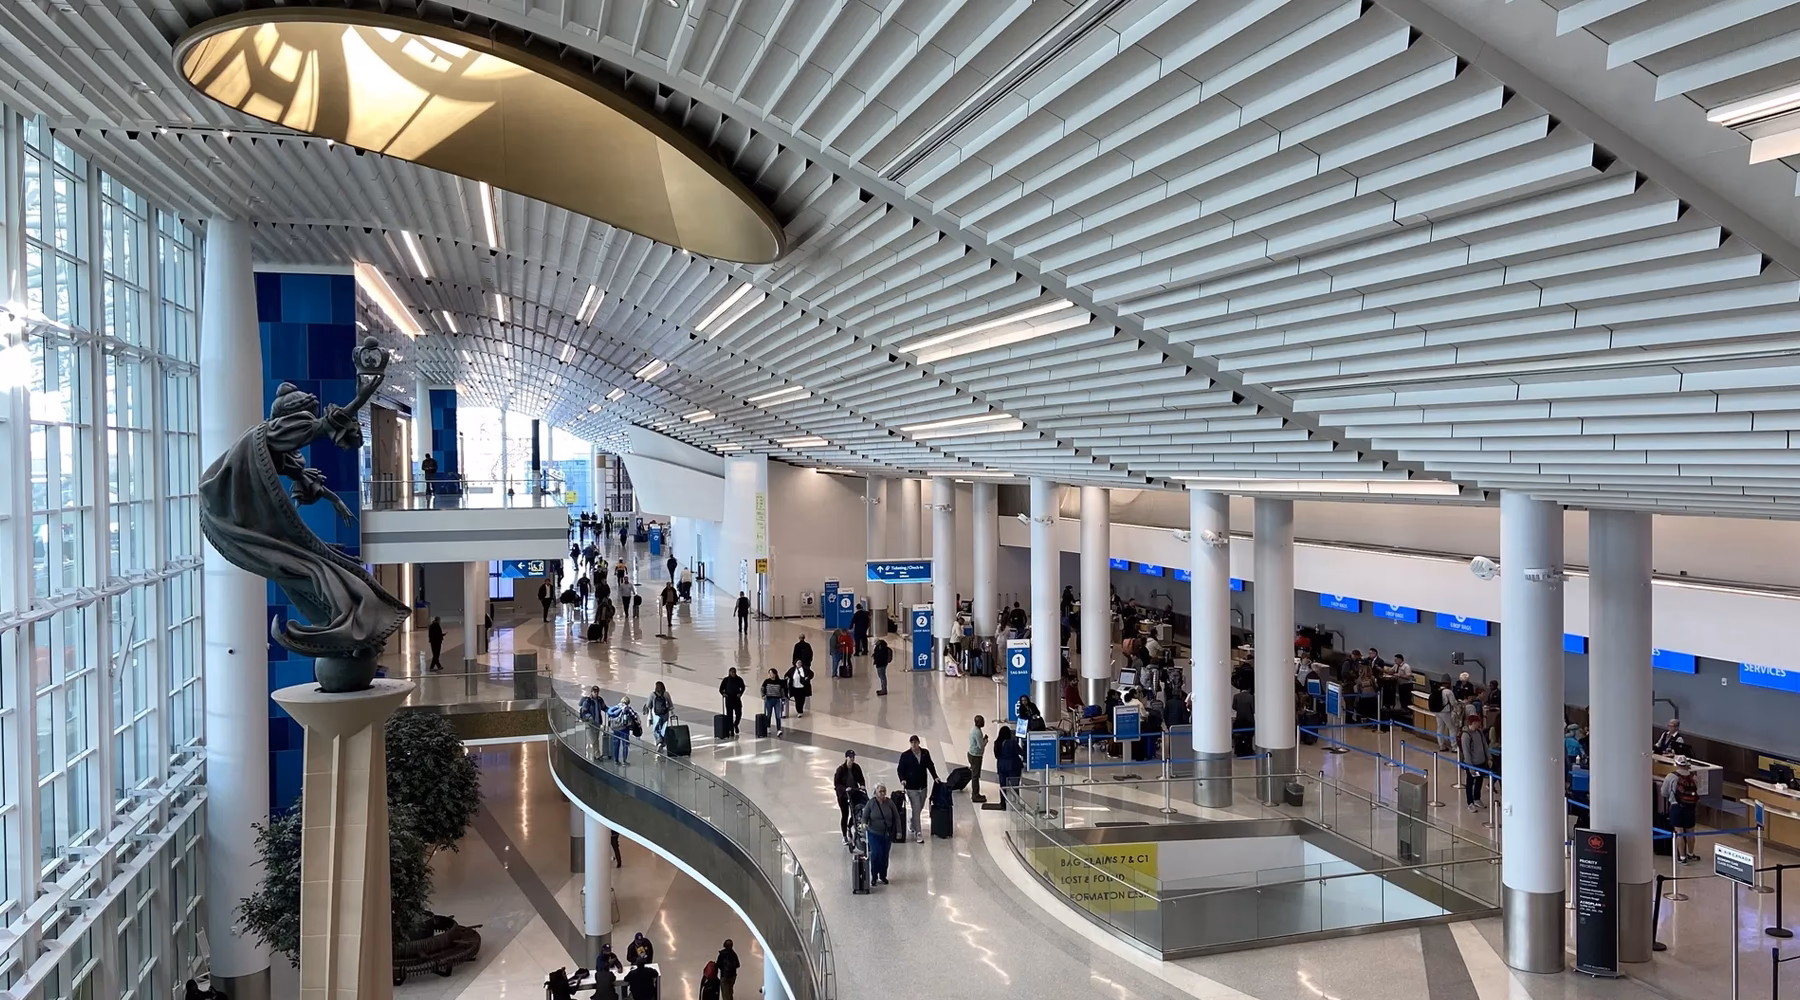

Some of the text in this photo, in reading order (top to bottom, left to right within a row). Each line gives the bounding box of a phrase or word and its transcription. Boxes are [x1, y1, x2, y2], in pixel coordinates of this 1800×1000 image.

[1016, 656, 1020, 665] 1
[1744, 663, 1786, 677] SERVICES
[1061, 858, 1080, 867] BAG
[1128, 855, 1134, 863] &
[1137, 854, 1149, 863] C1
[1061, 876, 1082, 884] LOST
